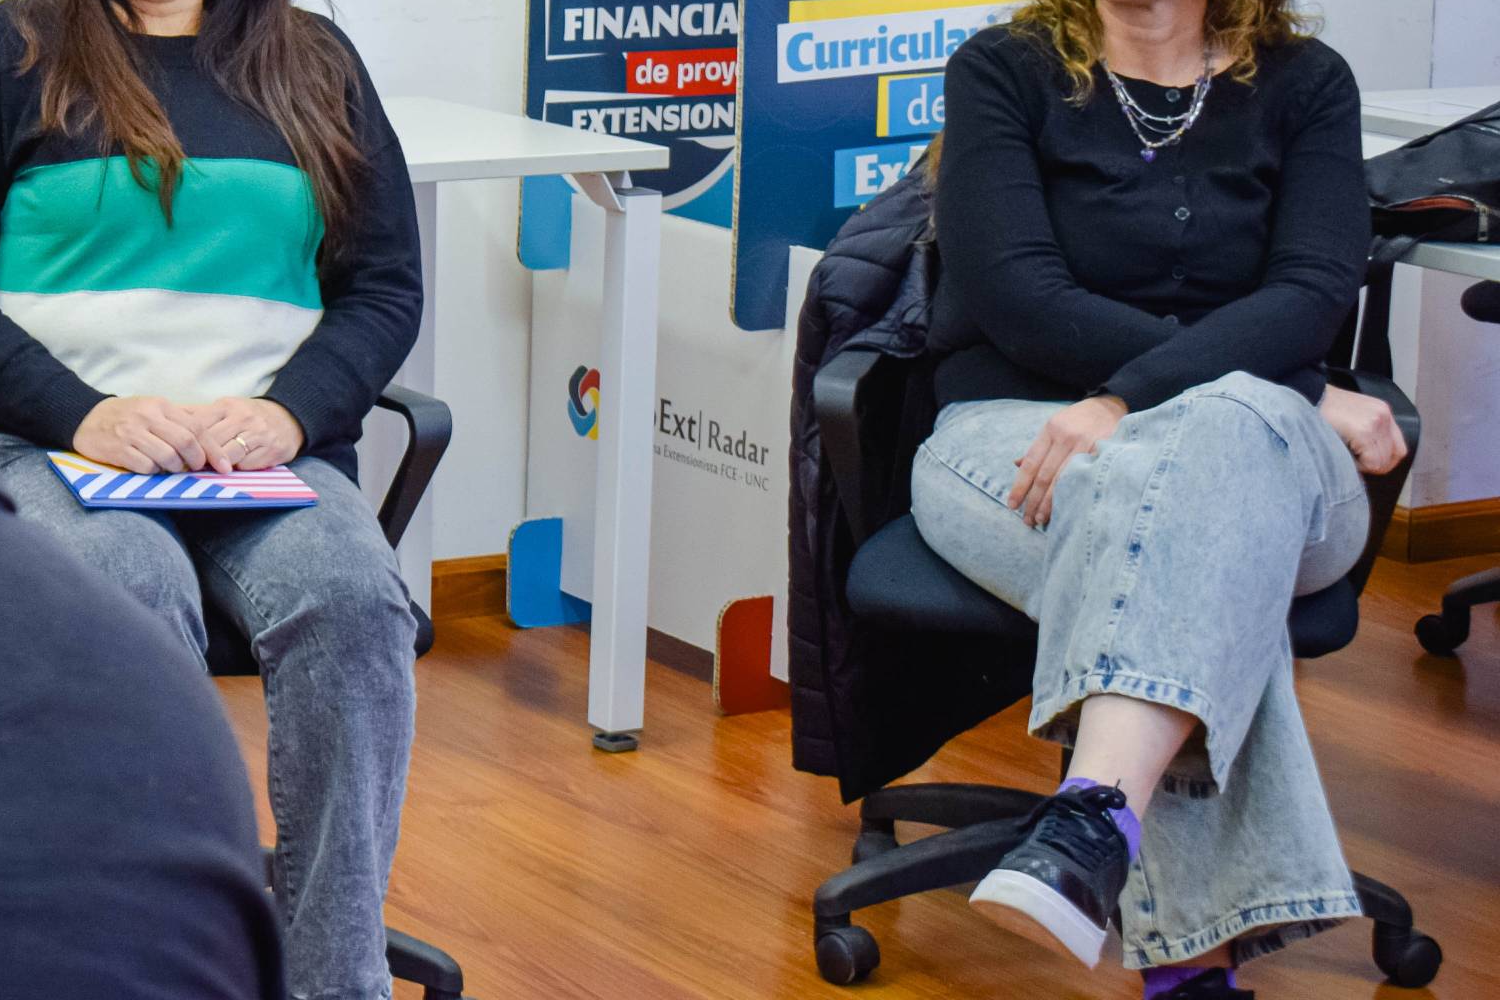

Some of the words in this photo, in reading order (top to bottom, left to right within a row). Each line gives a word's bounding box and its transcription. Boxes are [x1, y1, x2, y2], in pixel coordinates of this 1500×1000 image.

[563, 2, 738, 42] FINANCIA
[635, 58, 669, 85] de
[572, 101, 735, 134] EXTENSION
[907, 83, 945, 126] de
[708, 420, 769, 465] Radar
[745, 472, 770, 492] UNC
